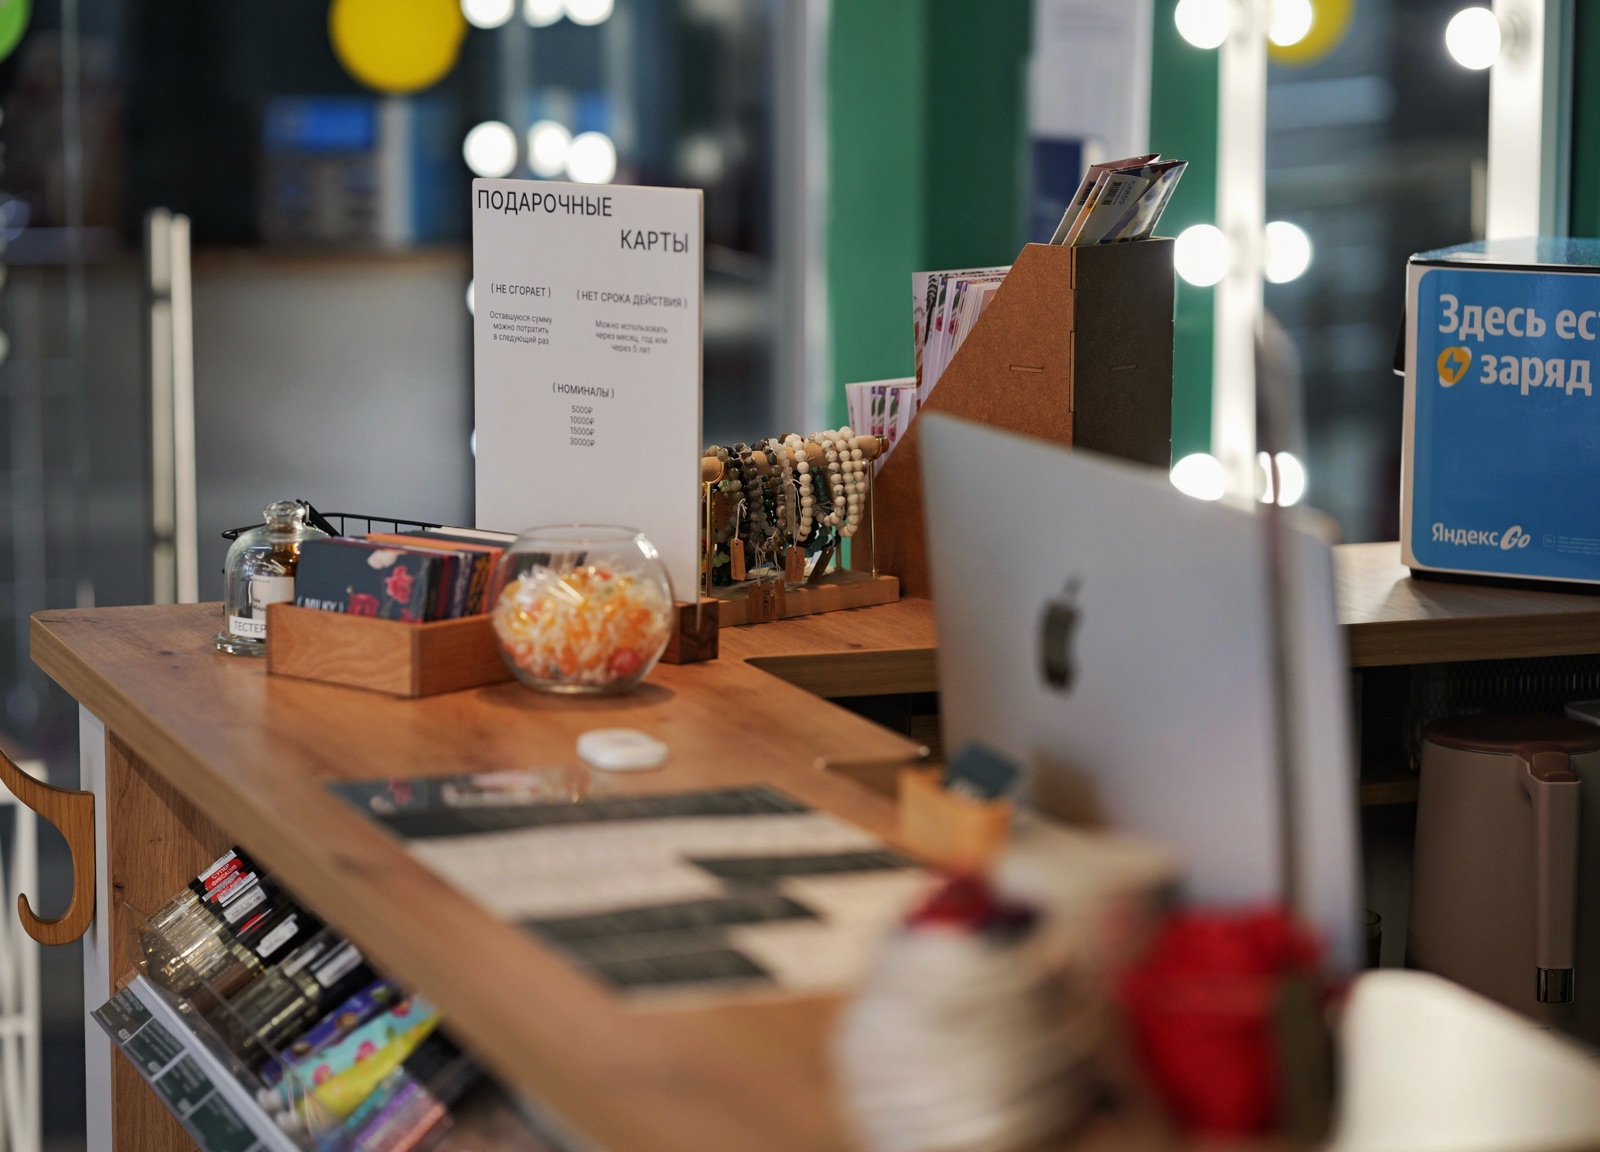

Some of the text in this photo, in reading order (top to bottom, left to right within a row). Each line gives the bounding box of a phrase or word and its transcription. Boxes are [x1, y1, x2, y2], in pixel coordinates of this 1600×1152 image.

[478, 189, 612, 217] ПОДАРОЧНЫЕ
[621, 229, 688, 253] КАРТЫ
[601, 292, 630, 304] СРОКА
[490, 311, 553, 325] Оставшуюся сумму
[1439, 293, 1600, 342] Здесь ес
[493, 323, 549, 335] можно потратить
[595, 320, 668, 334] Можно использовать
[498, 334, 537, 344] следующий
[537, 338, 549, 346] раз
[595, 332, 615, 341] через
[641, 335, 654, 344] год
[611, 344, 651, 354] через 5 лет
[1480, 354, 1592, 396] заряд
[557, 383, 609, 398] НОМИНАЛЫ
[571, 405, 593, 414] 5000₽
[570, 415, 595, 425] 10000₽
[570, 426, 595, 436] 15000₽
[569, 437, 595, 447] 30000₽
[1432, 522, 1499, 547] Яндекс
[1500, 525, 1531, 550] Go
[233, 620, 267, 635] ТЕСТЕР
